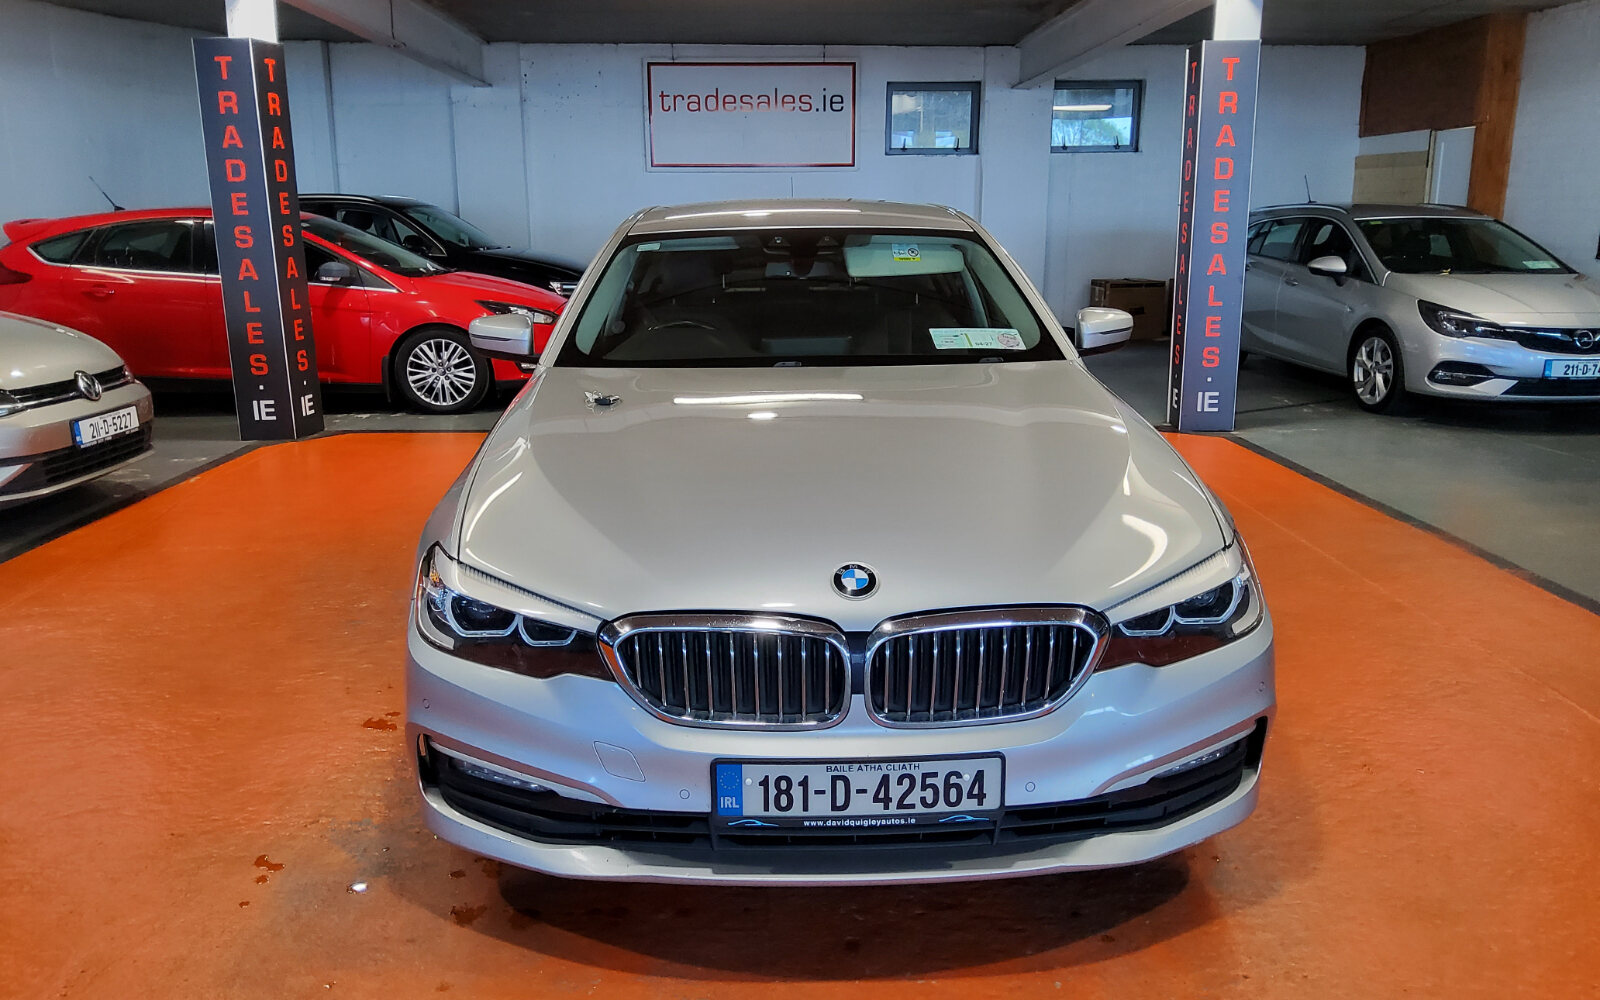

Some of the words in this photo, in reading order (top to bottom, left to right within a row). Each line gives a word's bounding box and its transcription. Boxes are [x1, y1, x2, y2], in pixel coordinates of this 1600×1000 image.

[658, 87, 845, 113] tradesales.ie
[1563, 363, 1600, 376] 211-D-7
[89, 412, 132, 439] 211-D-5227
[825, 764, 854, 773] BAILE
[856, 763, 883, 772] ATHA
[885, 763, 921, 772] CLIATH
[758, 769, 987, 813] 181-D-42564
[720, 796, 740, 809] IRL
[803, 817, 916, 827] www.davidquigleyautos.ie
